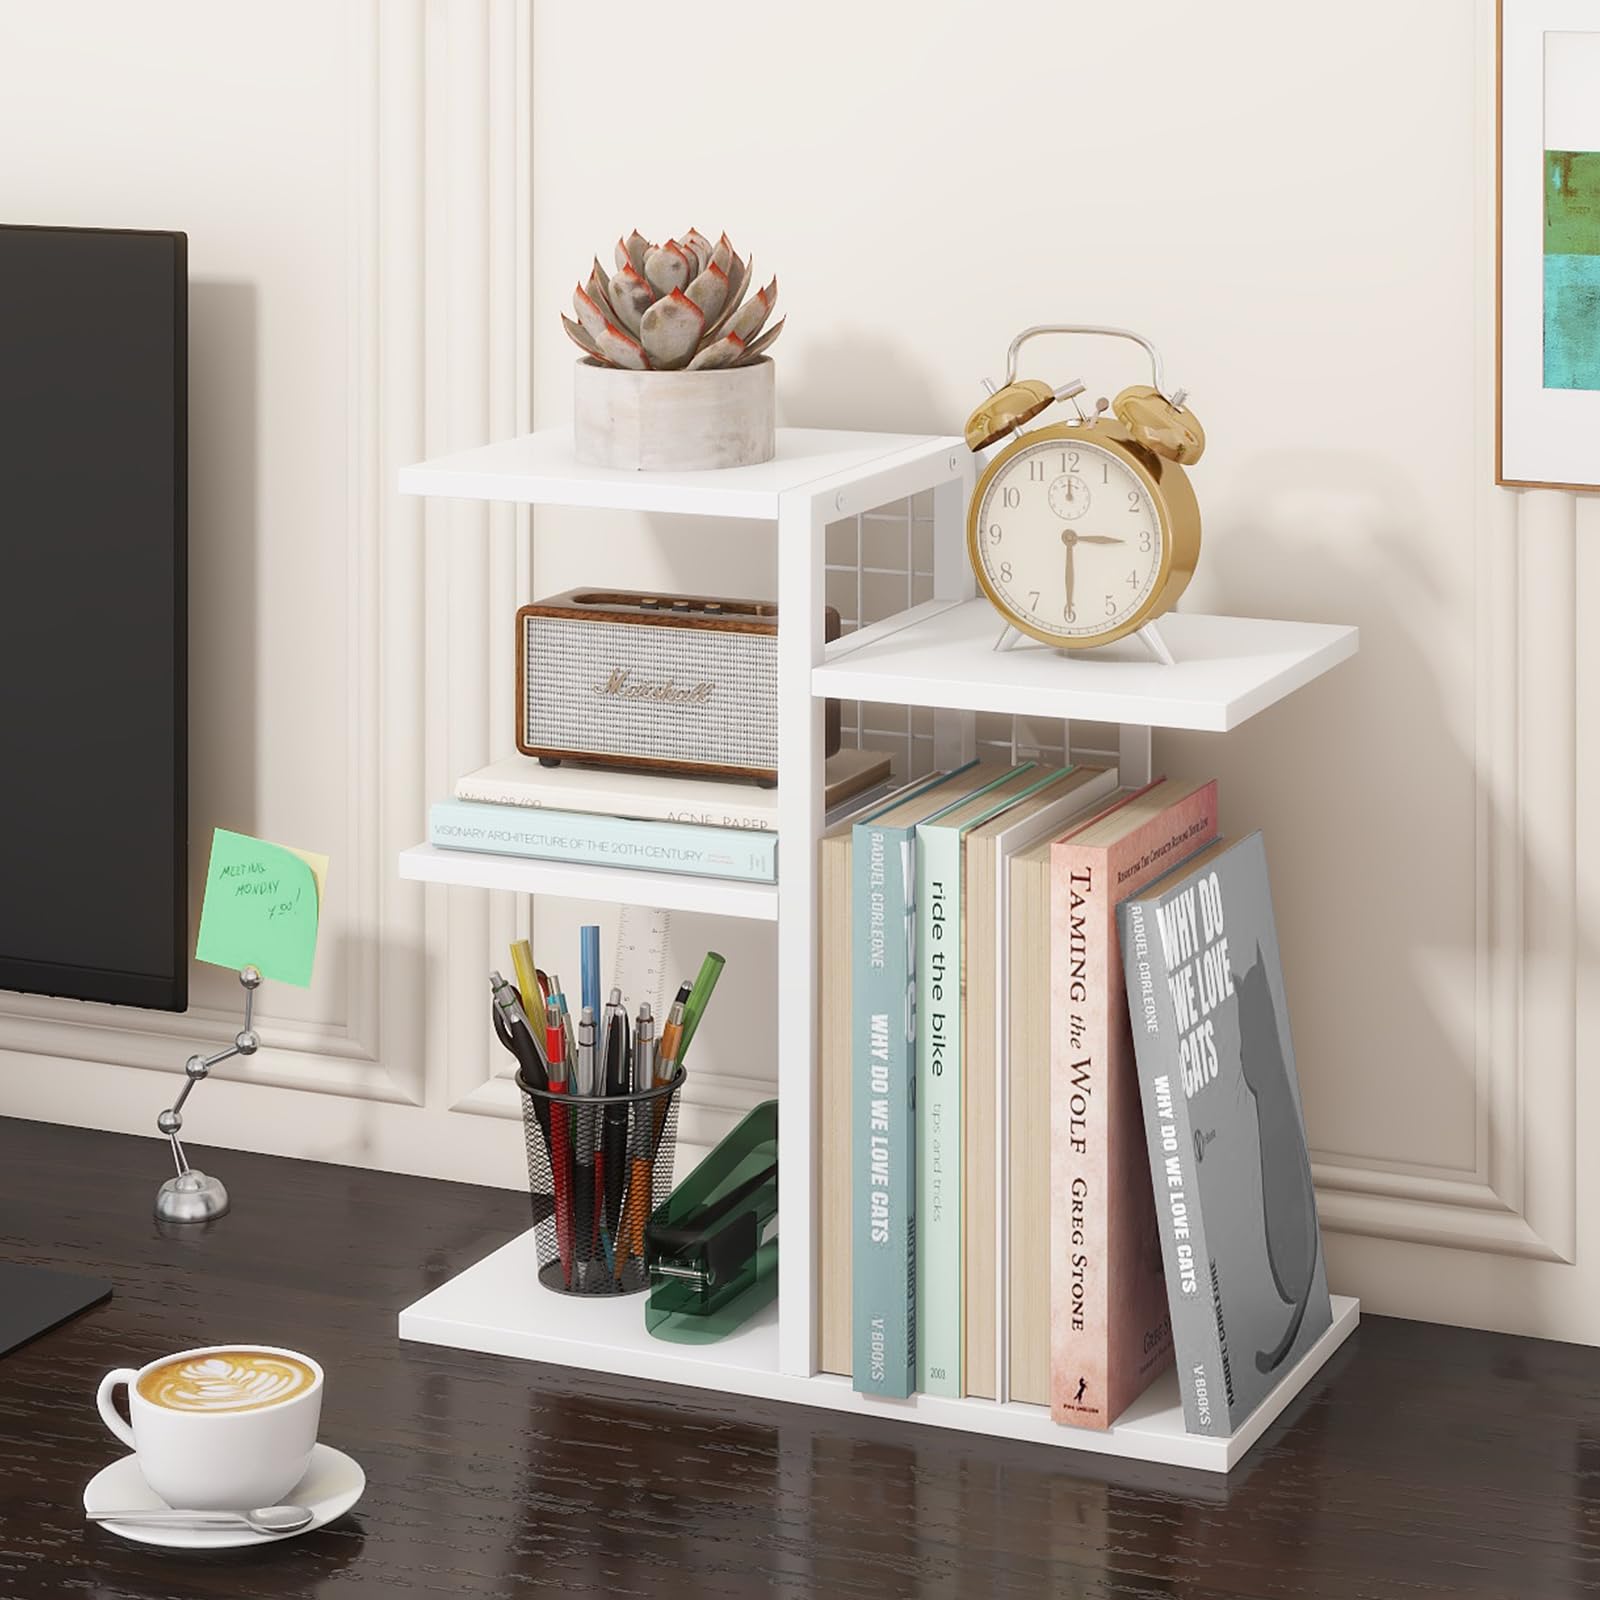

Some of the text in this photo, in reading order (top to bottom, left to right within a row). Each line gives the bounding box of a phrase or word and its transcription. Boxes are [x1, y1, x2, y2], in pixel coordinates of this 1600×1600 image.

[1029, 461, 1044, 481] 11
[1061, 453, 1079, 473] 12
[1102, 463, 1109, 484] 1
[1003, 487, 1020, 509] 10
[1127, 491, 1140, 513] 2
[989, 524, 1002, 546] 9
[1139, 531, 1151, 553] 3
[1000, 562, 1013, 583] 8
[1126, 569, 1140, 590] 4
[1028, 591, 1040, 612] 7
[1063, 601, 1077, 624] 6
[1105, 594, 1117, 616] 5
[593, 668, 716, 704] Marshall
[434, 823, 485, 839] VISIONARY
[487, 830, 568, 849] ARCHITECTURE
[569, 839, 585, 849] OF
[588, 840, 609, 853] THE
[611, 842, 644, 856] 20TH
[645, 845, 703, 862] CENTURY
[871, 891, 885, 968] CORLEONE
[1155, 871, 1224, 969] WHY DO
[932, 881, 946, 1077] ride the bike
[1168, 937, 1235, 1035] WE LOVE
[1070, 867, 1092, 1155] TAMING the WOLF
[1139, 963, 1159, 1033] CORLEONE
[1179, 1019, 1220, 1099] CATS
[871, 1013, 889, 1243] WHY DO WE LOVE CATS
[930, 1103, 942, 1223] tips and tricks
[1154, 1075, 1197, 1295] WHY DO WE LOVE CATS
[1071, 1177, 1087, 1331] GREG STONE
